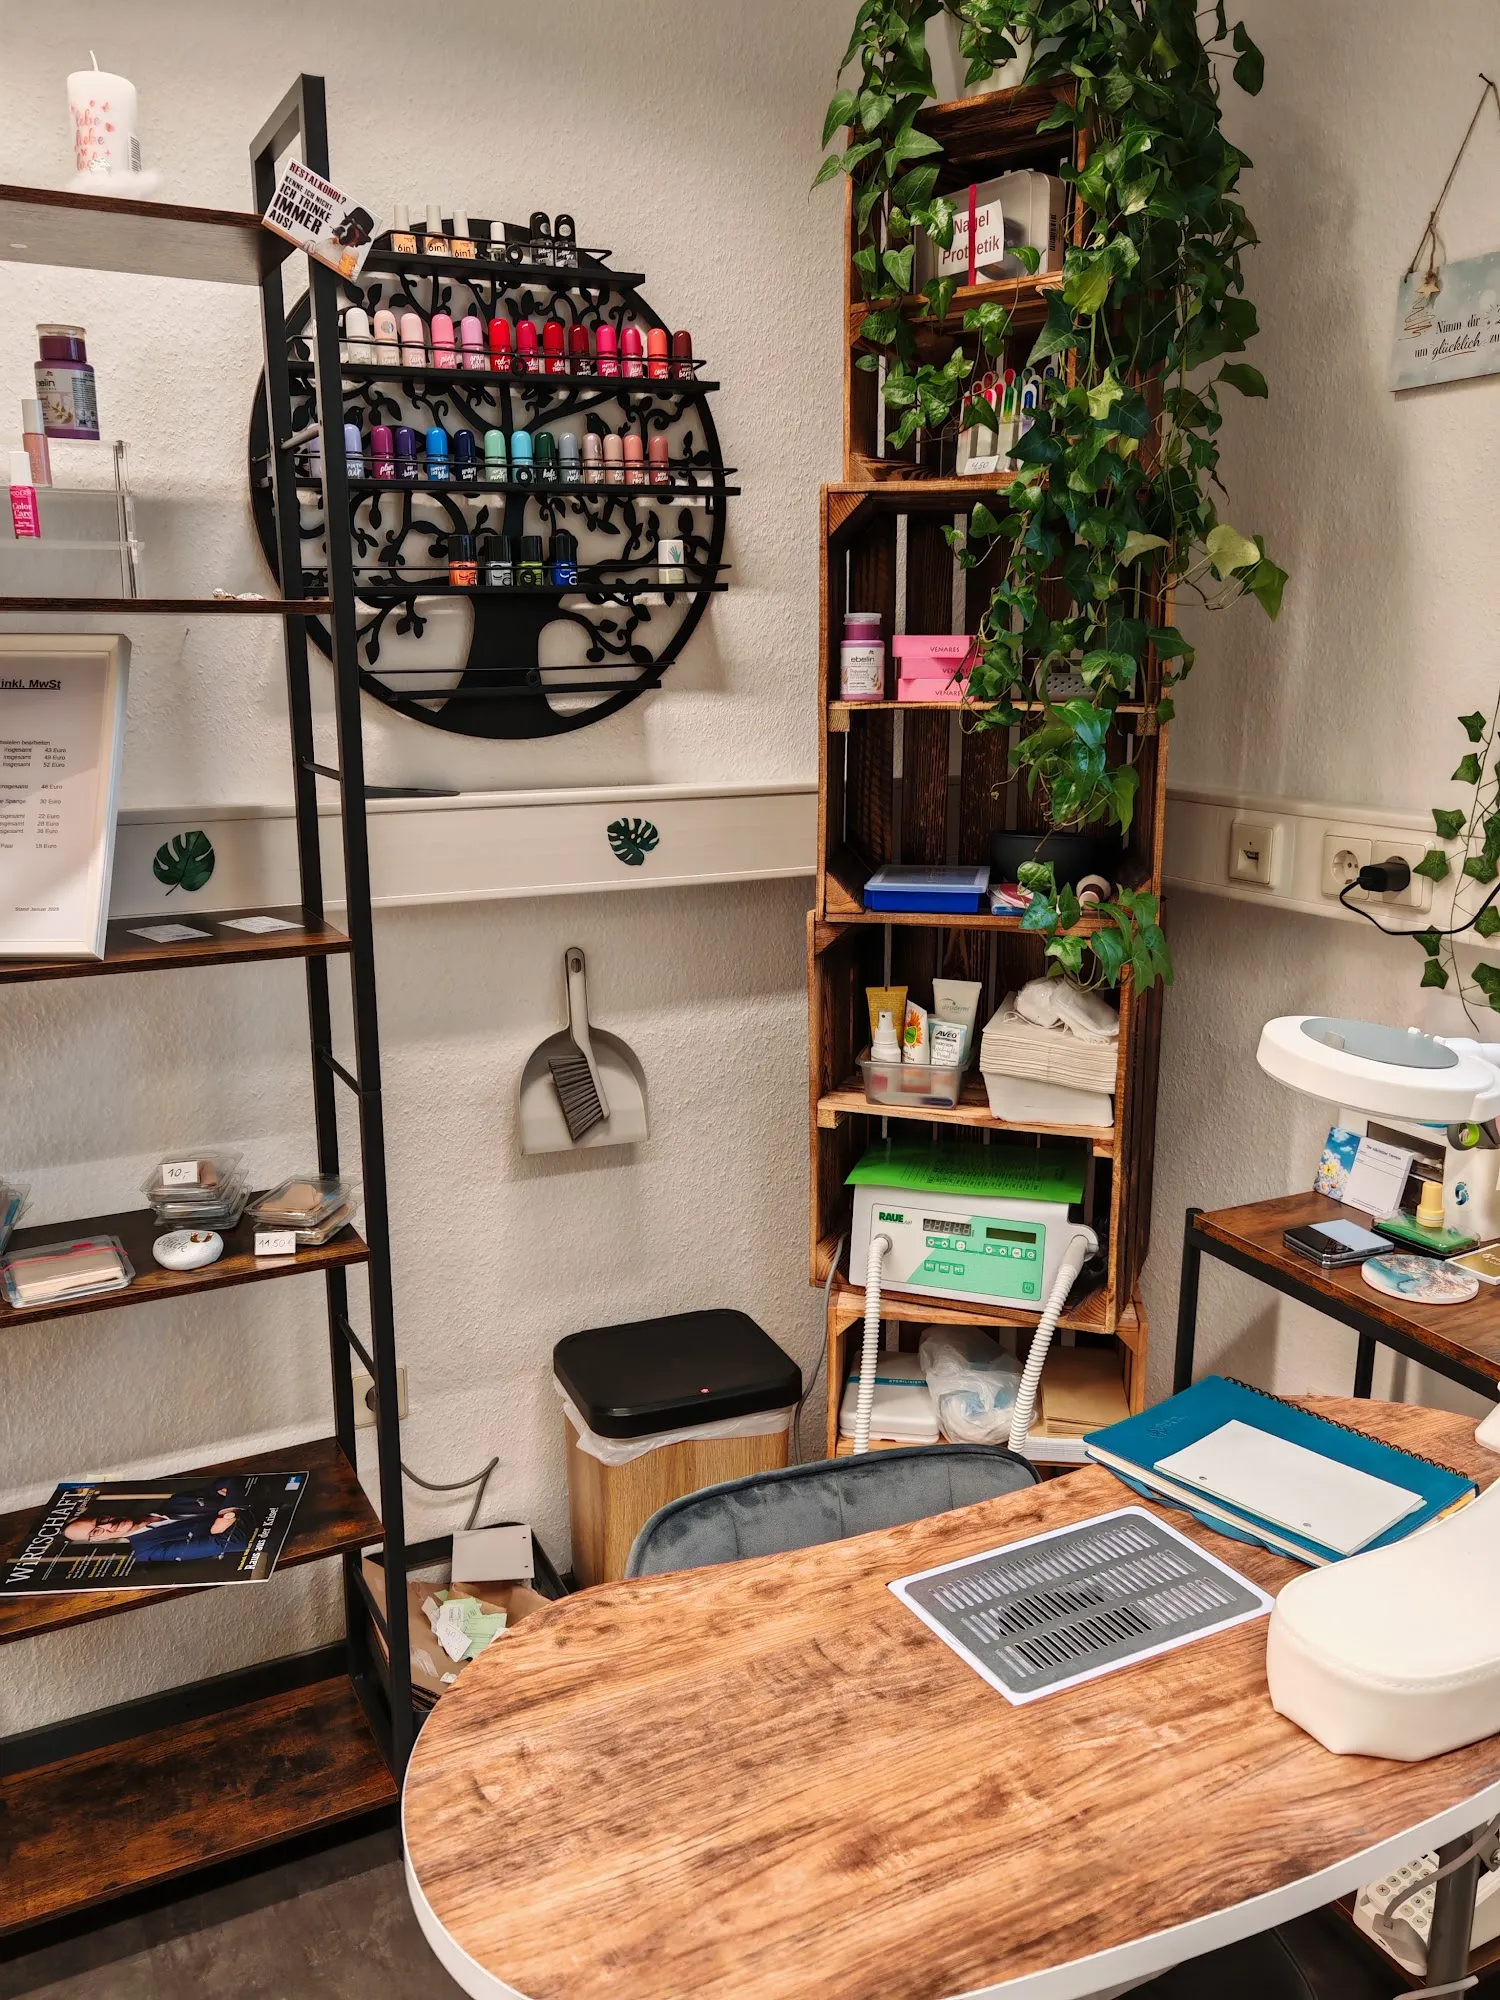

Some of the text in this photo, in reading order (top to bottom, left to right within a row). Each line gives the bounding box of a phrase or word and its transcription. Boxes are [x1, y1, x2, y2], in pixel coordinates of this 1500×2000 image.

[284, 176, 304, 193] KENNE
[304, 188, 315, 200] ICH
[289, 162, 347, 205] RESTALKOHOL?
[280, 183, 332, 223] ICH TRINKE
[268, 209, 294, 230] AUS!
[273, 194, 323, 235] IMMER
[953, 210, 989, 235] Nael
[397, 243, 415, 252] 6in1
[428, 243, 446, 252] 6in1
[454, 249, 471, 258] 6in1
[942, 235, 1000, 264] Protetik
[1436, 314, 1481, 334] Nimm dir
[1414, 348, 1428, 358] um
[1432, 332, 1481, 361] glücklich
[12, 502, 32, 510] Color
[1, 679, 61, 689] inkl. MwSt
[168, 1168, 190, 1179] 10,-
[879, 1212, 904, 1222] RAUE
[263, 1507, 280, 1527] Krise!
[6, 1490, 84, 1585] WiRTSCHAFT
[260, 1526, 271, 1539] der
[255, 1538, 266, 1553] aus
[244, 1551, 261, 1571] Raus
